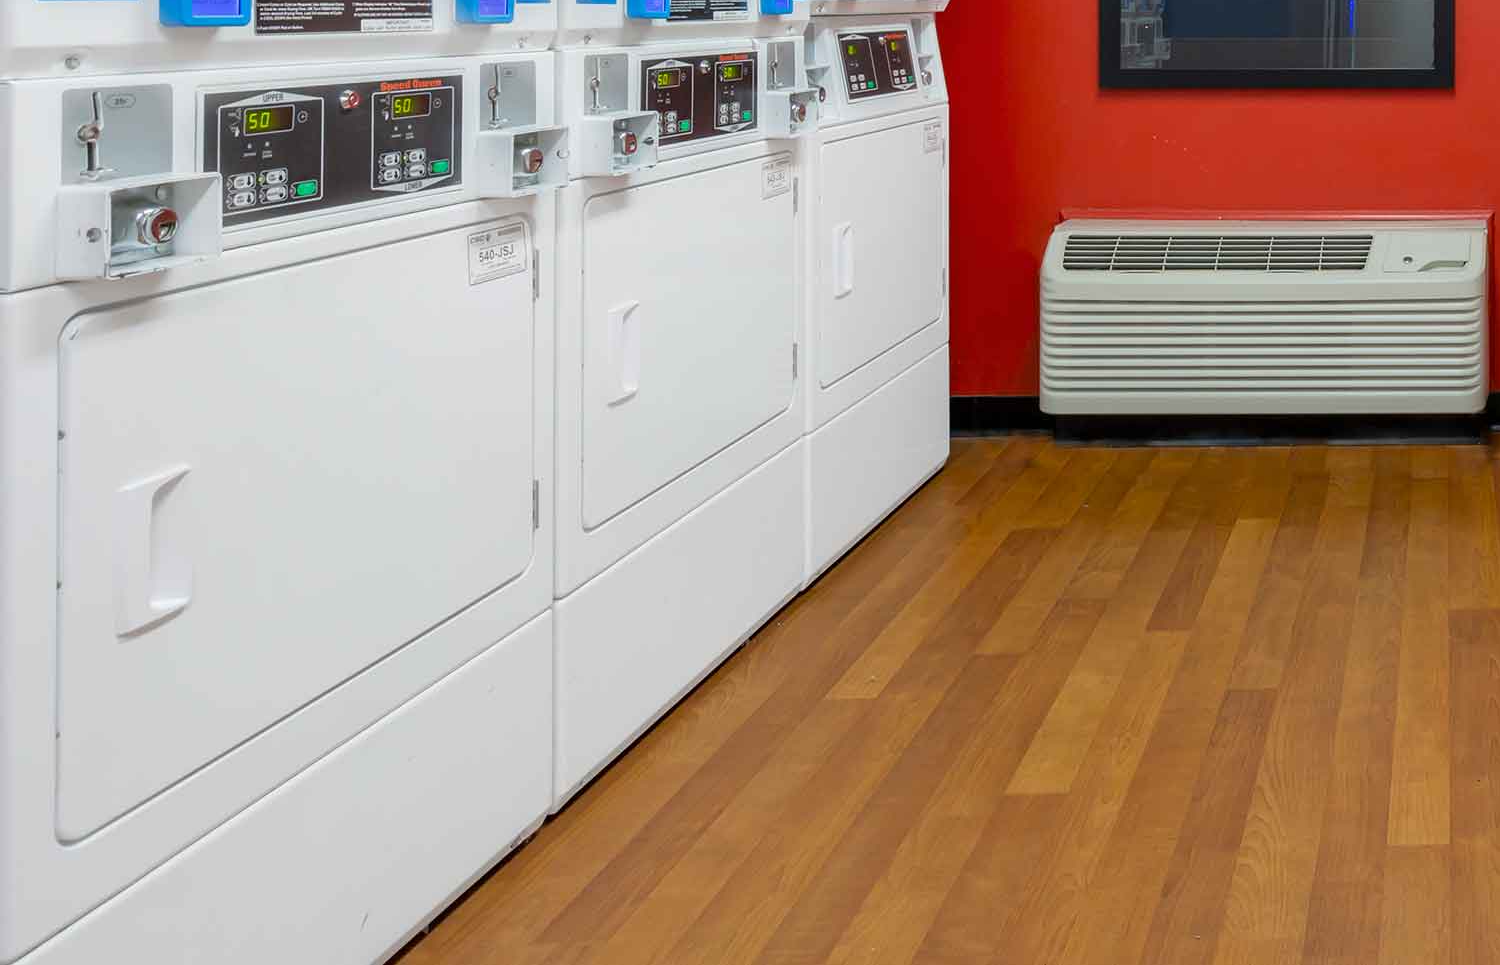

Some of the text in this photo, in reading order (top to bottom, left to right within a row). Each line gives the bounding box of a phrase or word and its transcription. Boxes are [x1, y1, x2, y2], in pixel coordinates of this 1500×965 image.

[262, 93, 284, 102] UPPER
[394, 98, 411, 114] 50
[248, 112, 270, 129] 50
